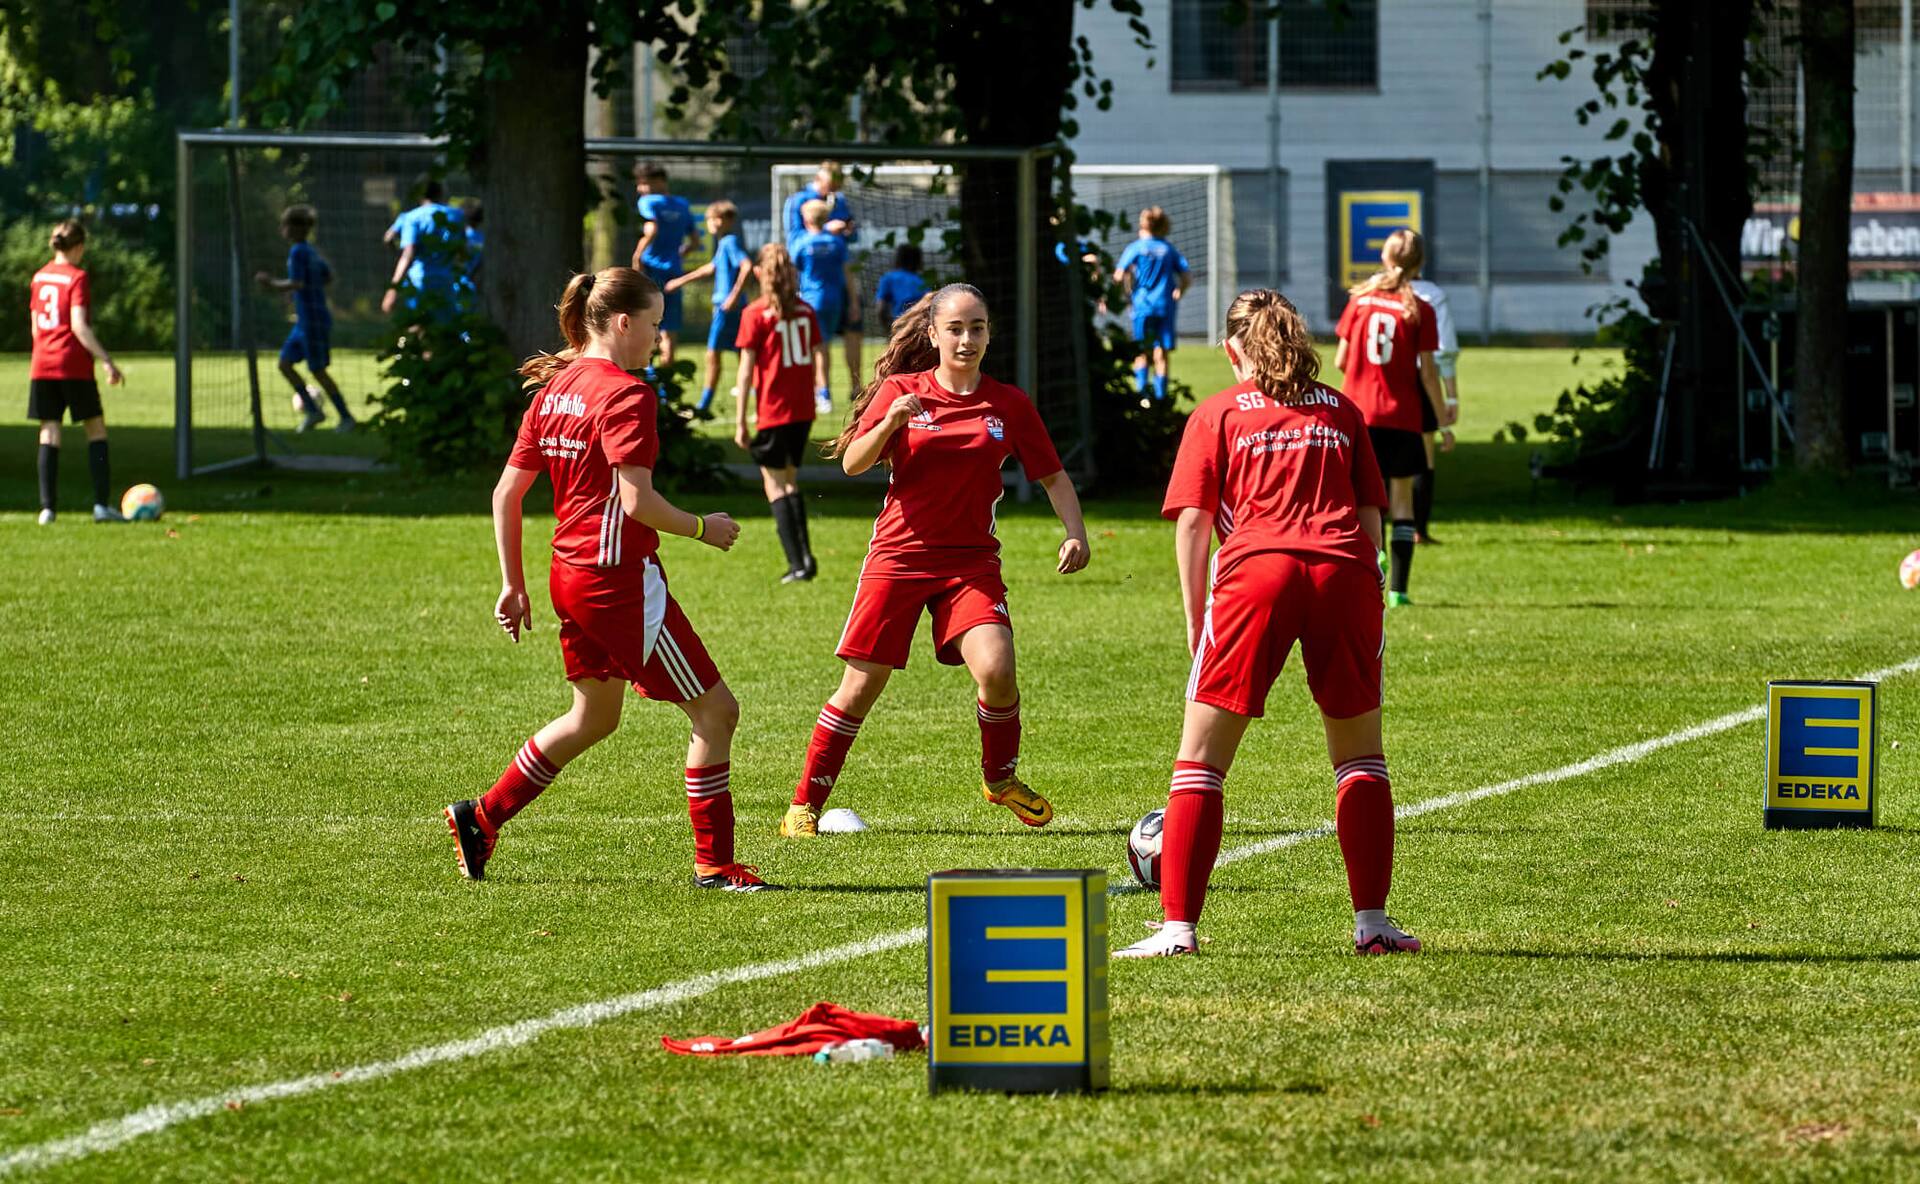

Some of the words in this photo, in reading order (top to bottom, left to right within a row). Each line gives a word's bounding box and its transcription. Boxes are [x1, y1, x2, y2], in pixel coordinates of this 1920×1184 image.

[1741, 218, 1785, 256] Wir
[1848, 218, 1920, 256] eben
[38, 285, 59, 331] 3
[775, 317, 812, 368] 10
[1235, 391, 1266, 411] SG
[1237, 428, 1301, 452] AUTOHAUS
[1778, 783, 1860, 800] EDEKA
[950, 1025, 1071, 1047] EDEKA
